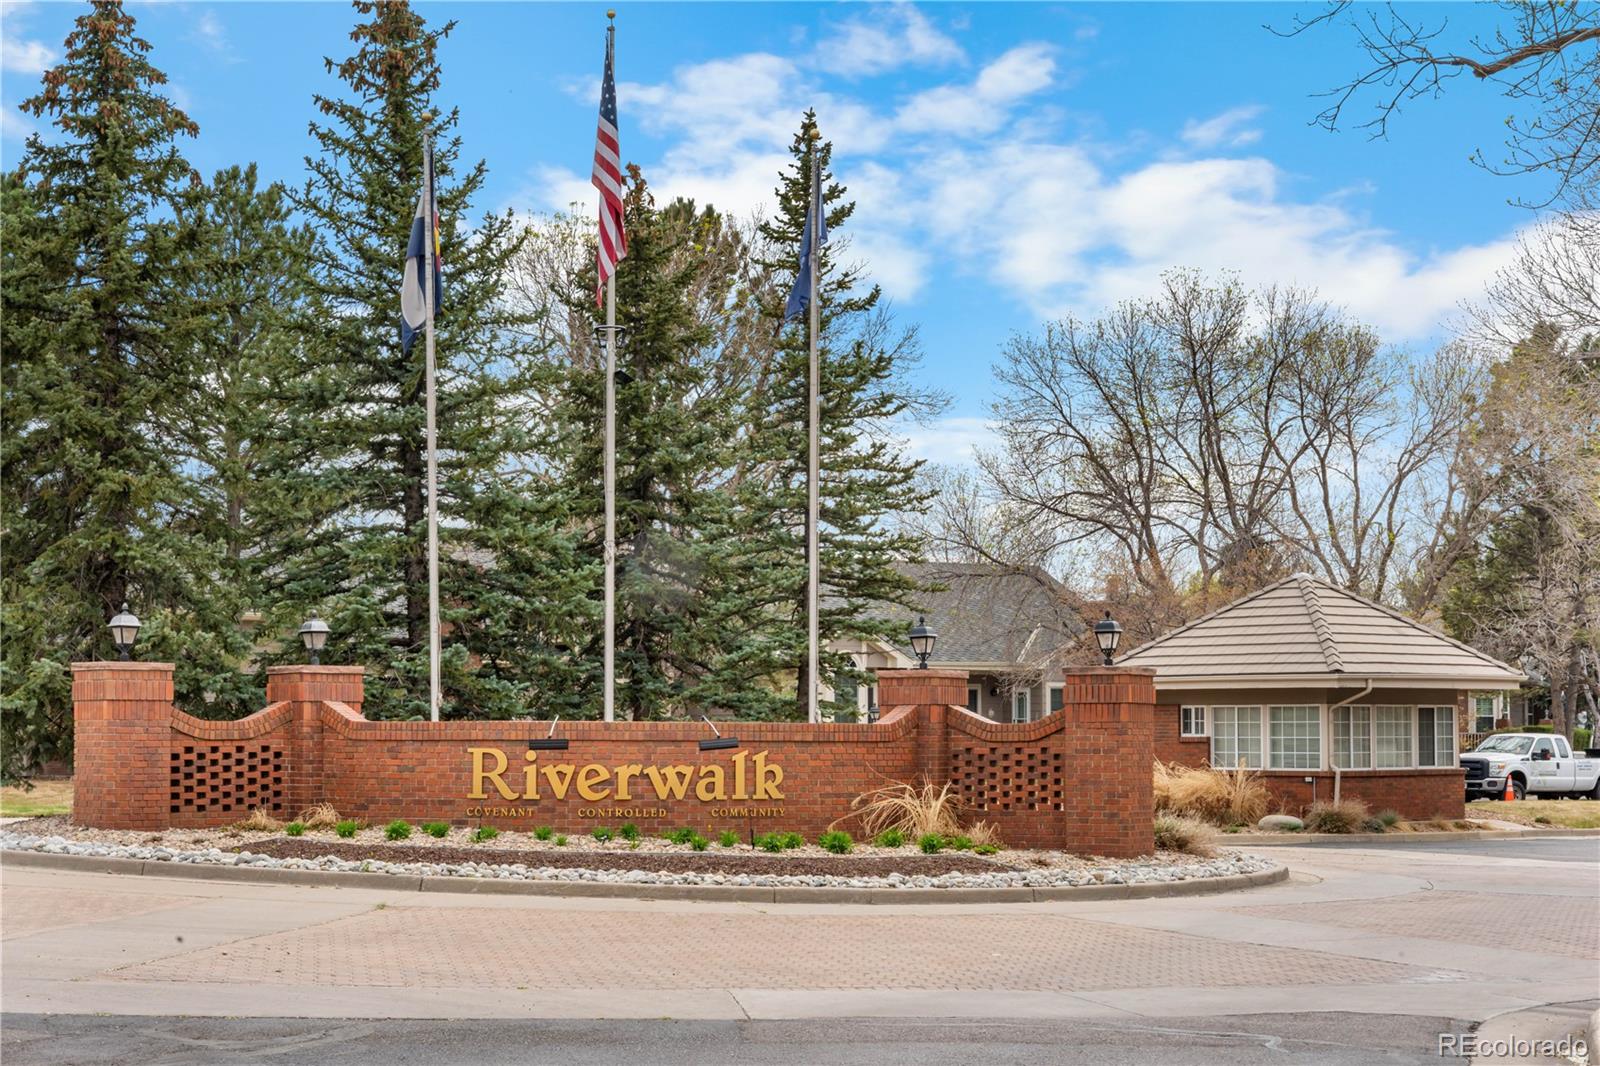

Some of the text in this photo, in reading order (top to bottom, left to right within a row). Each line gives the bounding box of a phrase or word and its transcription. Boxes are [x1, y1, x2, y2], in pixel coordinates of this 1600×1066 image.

[466, 747, 787, 802] Riverwalk
[466, 806, 786, 819] COVENANT CONTROLLED COMMUNITY
